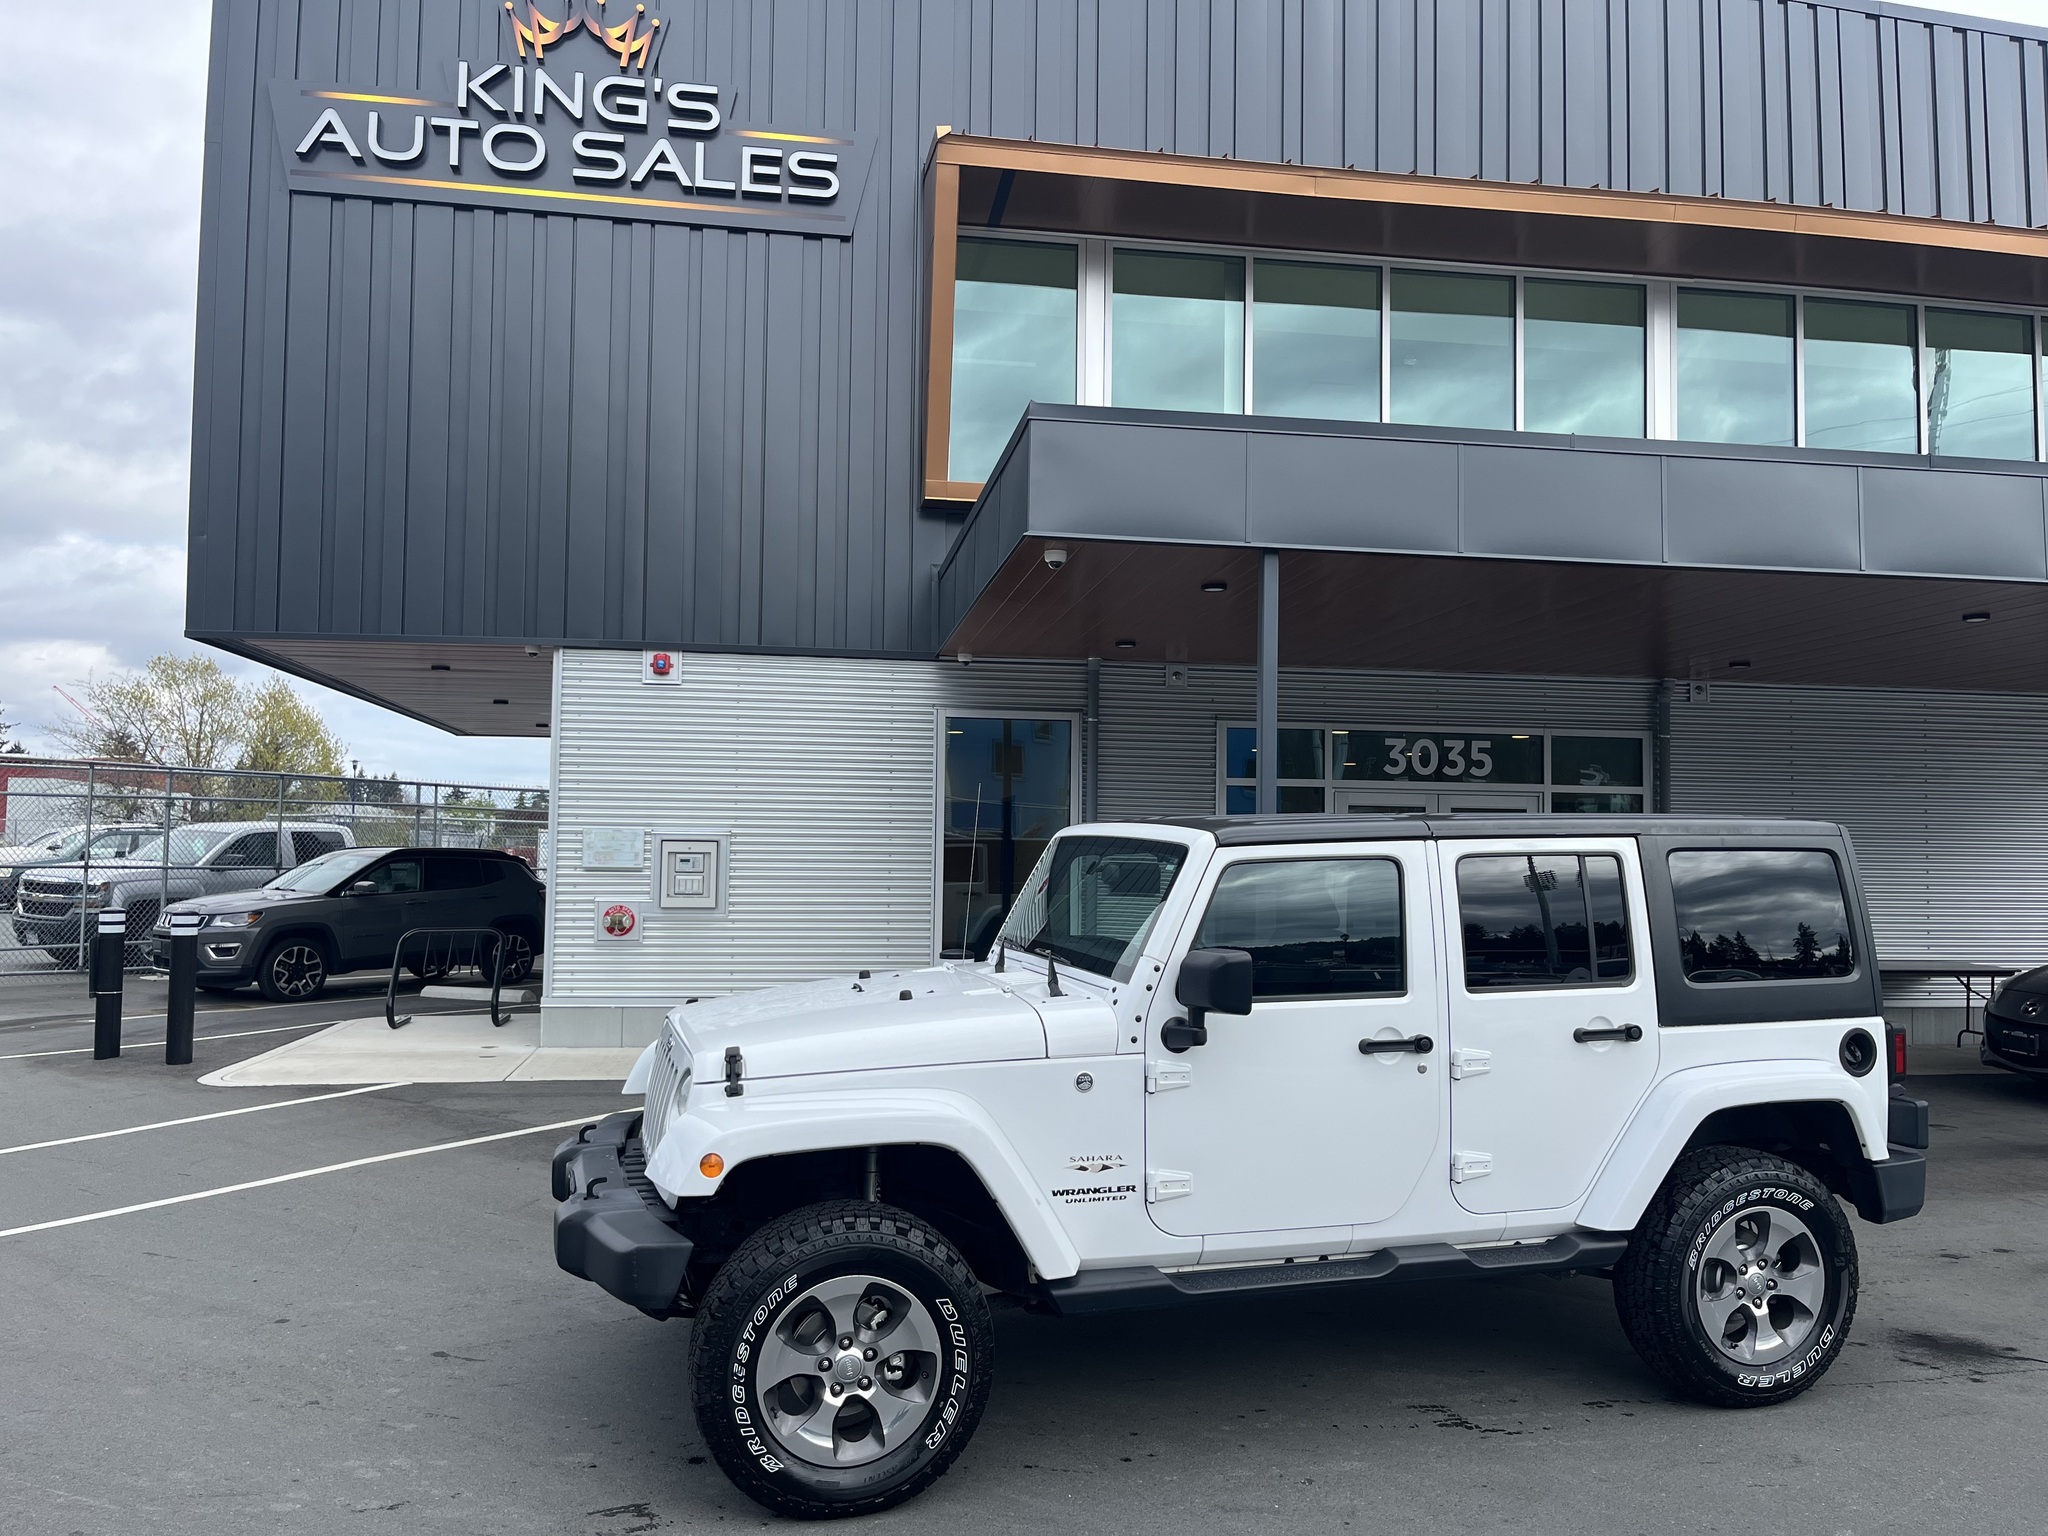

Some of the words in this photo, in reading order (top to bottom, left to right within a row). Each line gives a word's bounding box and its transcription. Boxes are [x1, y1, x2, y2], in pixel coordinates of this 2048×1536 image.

[457, 60, 722, 132] KING'S
[295, 107, 548, 174] AUTO
[571, 133, 841, 200] SALES
[1383, 738, 1493, 777] 3035
[1052, 1185, 1137, 1197] WRANGLER
[1066, 1195, 1127, 1204] UNLIMITED
[1688, 1187, 1814, 1271] BRIDGESTONE
[732, 1273, 798, 1473] BRIDGESTONE
[925, 1298, 968, 1450] DUELER
[1700, 1340, 1719, 1363] ASCENT
[1737, 1324, 1836, 1388] DUELER
[863, 1464, 899, 1484] ASCENT
